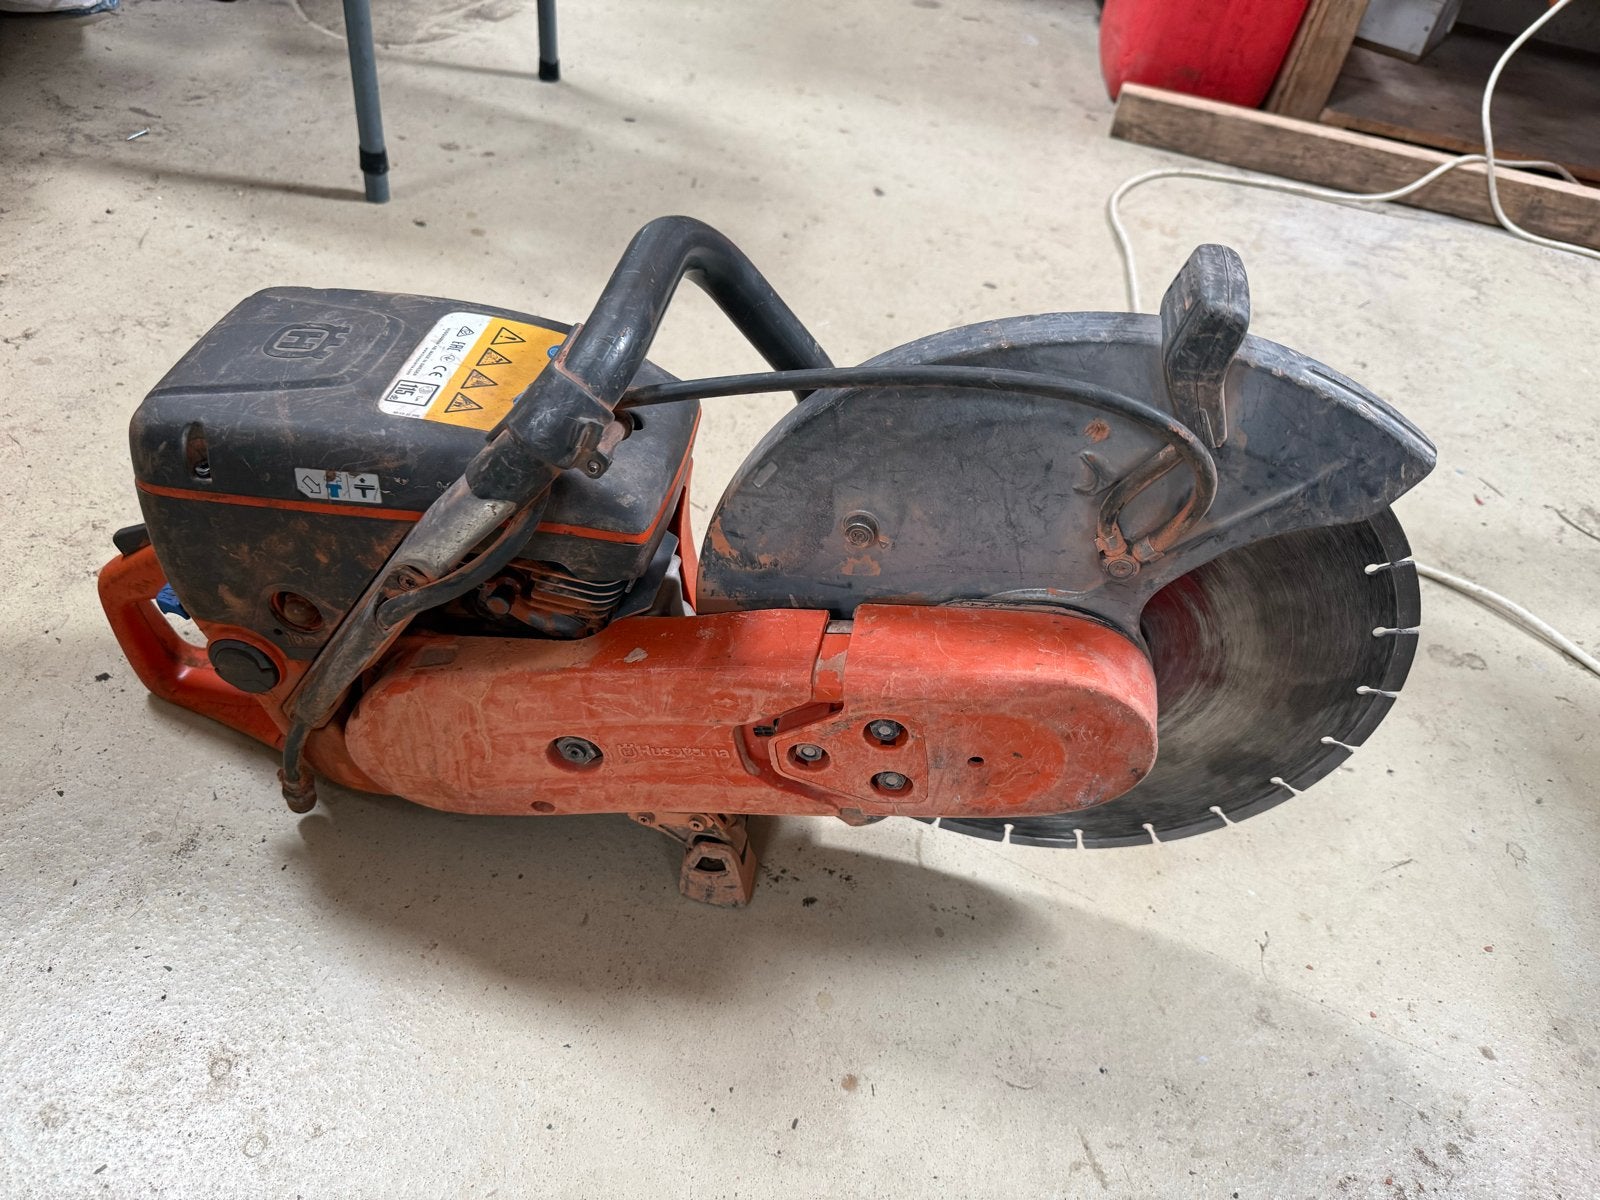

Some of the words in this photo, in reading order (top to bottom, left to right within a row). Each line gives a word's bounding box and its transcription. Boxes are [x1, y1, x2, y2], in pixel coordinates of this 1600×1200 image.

[428, 365, 447, 378] CE
[394, 383, 419, 396] 115
[640, 743, 731, 760] Husqvarna
